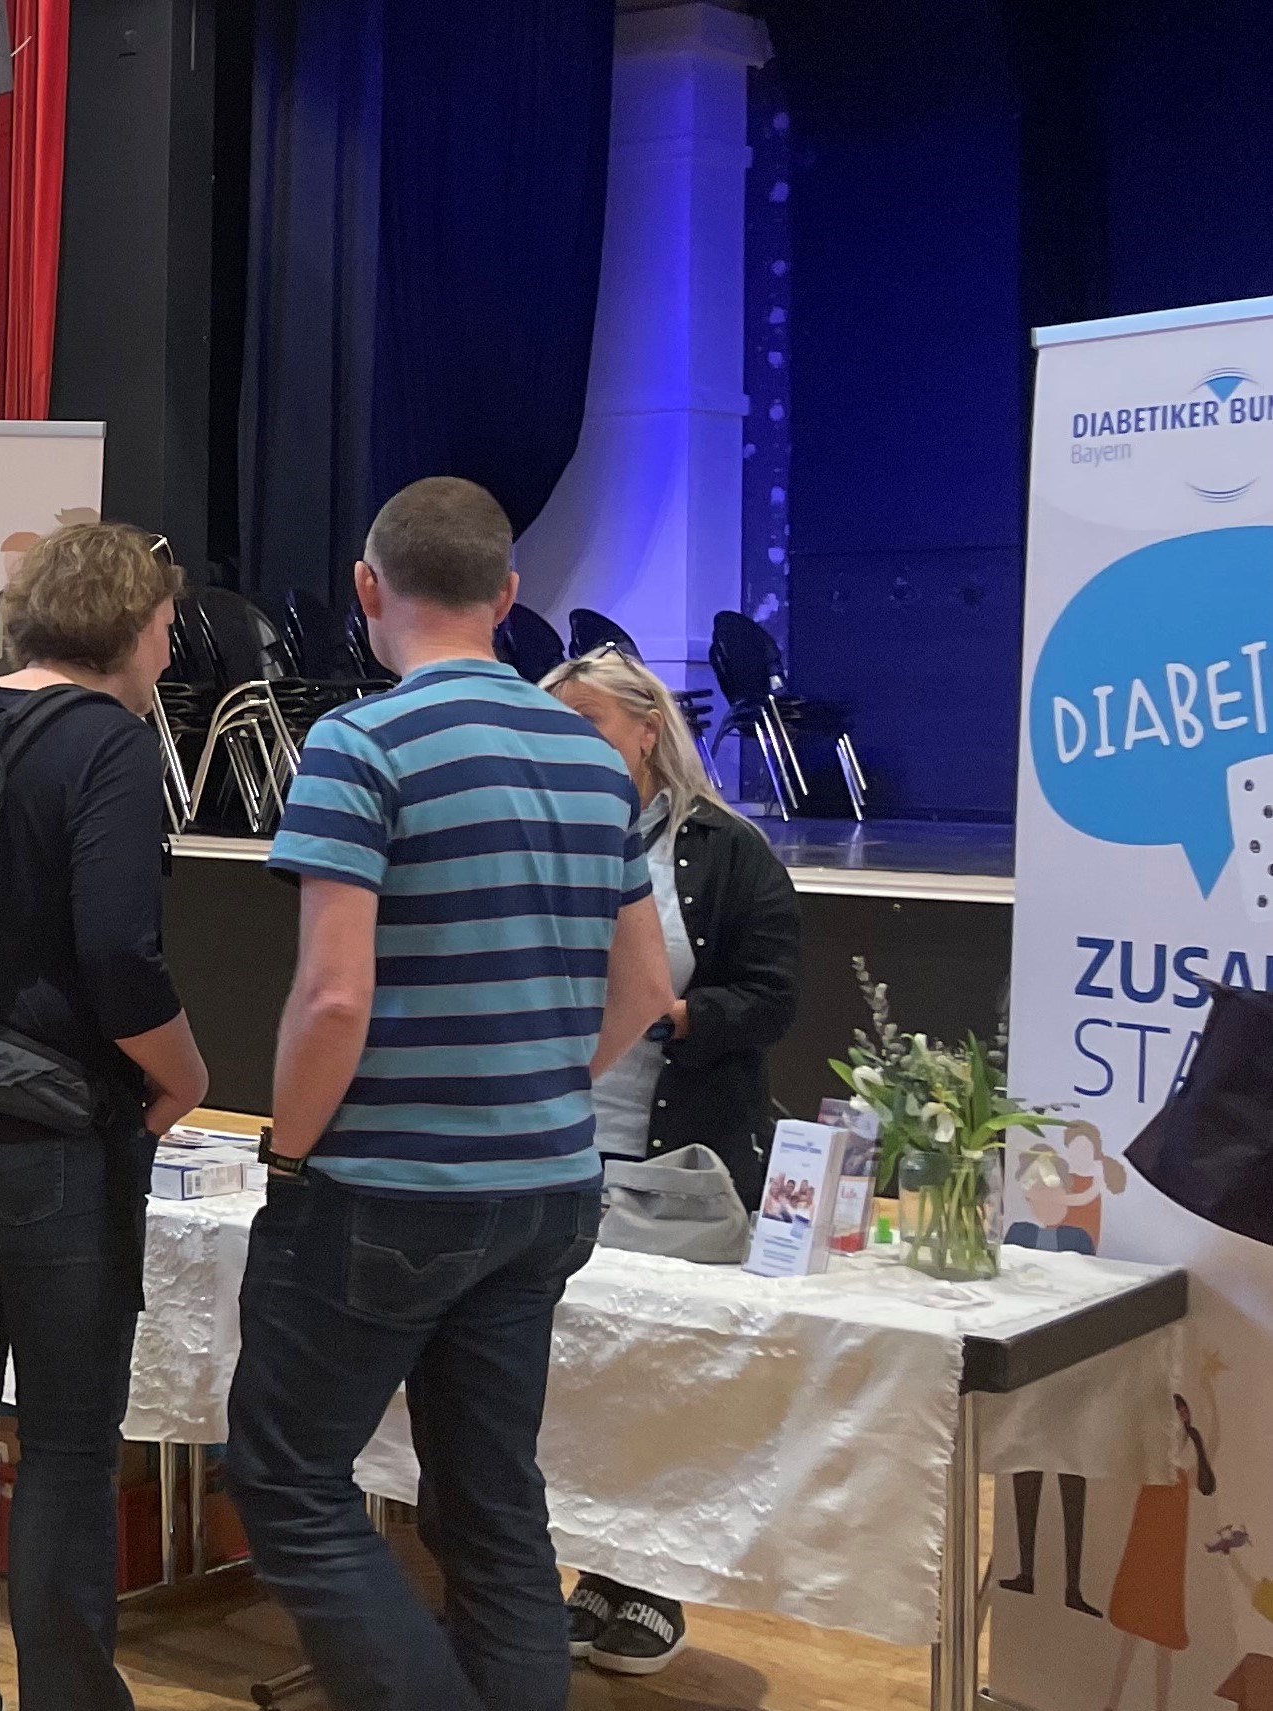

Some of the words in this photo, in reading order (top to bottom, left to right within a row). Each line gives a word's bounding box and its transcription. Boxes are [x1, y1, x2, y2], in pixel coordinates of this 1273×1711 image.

[1072, 400, 1220, 438] DIABETIKER
[1071, 443, 1132, 467] Bayern
[1053, 640, 1268, 764] DIABET
[1074, 936, 1273, 1009] ZUSA
